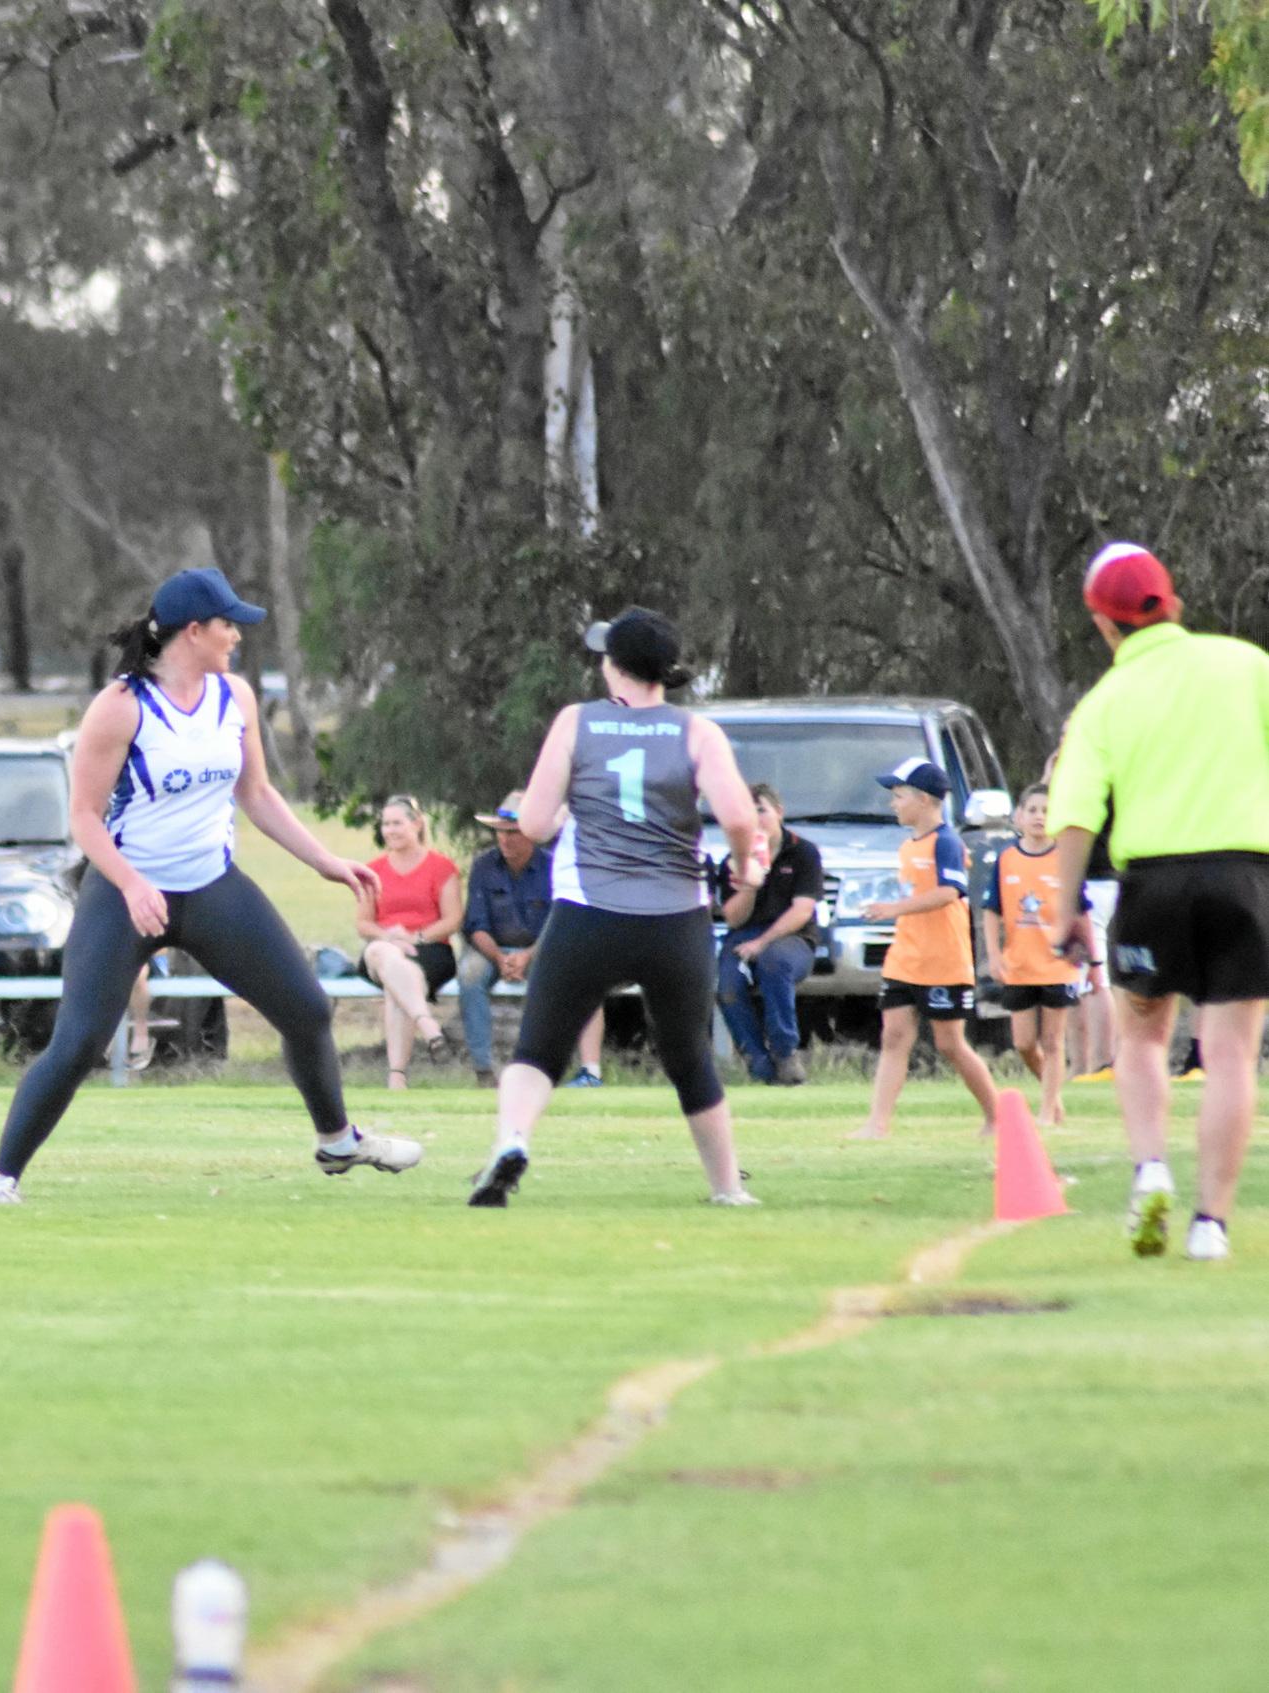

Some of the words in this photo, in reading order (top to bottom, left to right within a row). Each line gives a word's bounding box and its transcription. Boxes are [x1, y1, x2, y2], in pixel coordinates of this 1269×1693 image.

[620, 721, 655, 736] Not
[655, 722, 682, 737] Fit
[605, 748, 646, 822] 1
